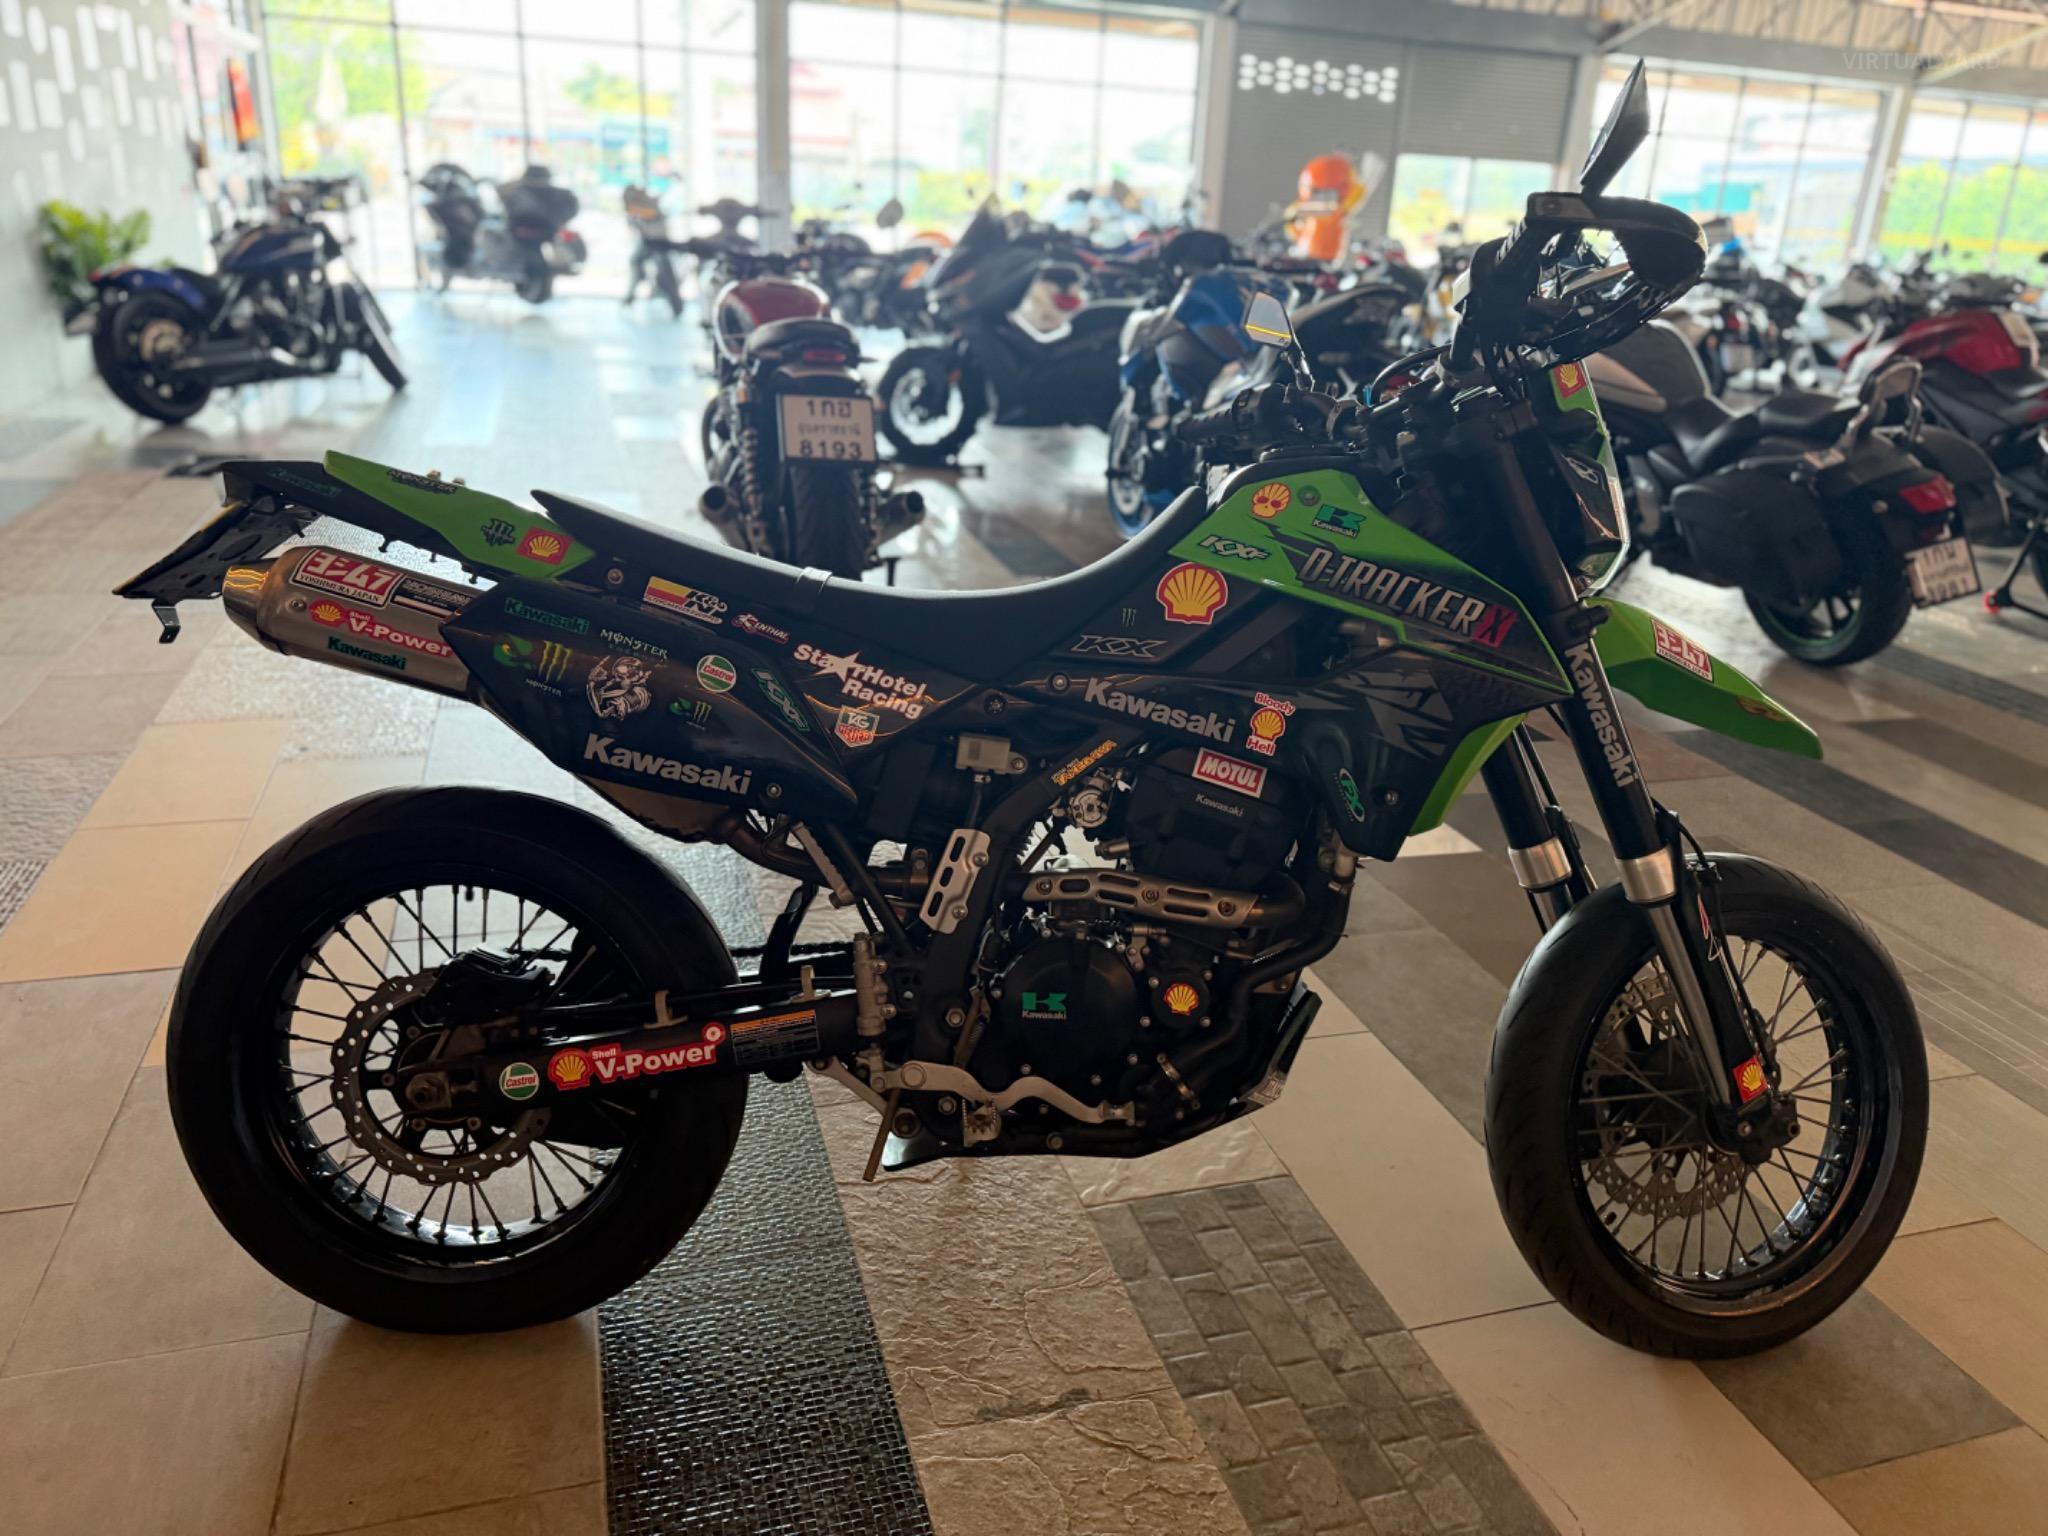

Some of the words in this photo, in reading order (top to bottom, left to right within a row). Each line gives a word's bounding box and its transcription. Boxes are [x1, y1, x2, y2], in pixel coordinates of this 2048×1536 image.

[799, 439, 863, 460] 8193
[505, 598, 590, 635] Kawasaki
[350, 616, 453, 656] V-Power
[328, 636, 407, 670] Kawasaki
[703, 664, 735, 683] Castrol
[841, 679, 924, 720] Racing
[1084, 677, 1236, 743] Kawasaki
[1255, 692, 1296, 715] Bloody
[1565, 644, 1639, 788] Kawasaki
[846, 711, 871, 729] TAG
[1247, 737, 1276, 755] Hell
[584, 733, 752, 795] Kawasaki
[1200, 756, 1259, 789] MOTUL
[1195, 793, 1245, 817] Kawasaki
[591, 1049, 616, 1061] Shell
[595, 1045, 717, 1079] V-Power
[505, 1074, 537, 1090] Castrol
